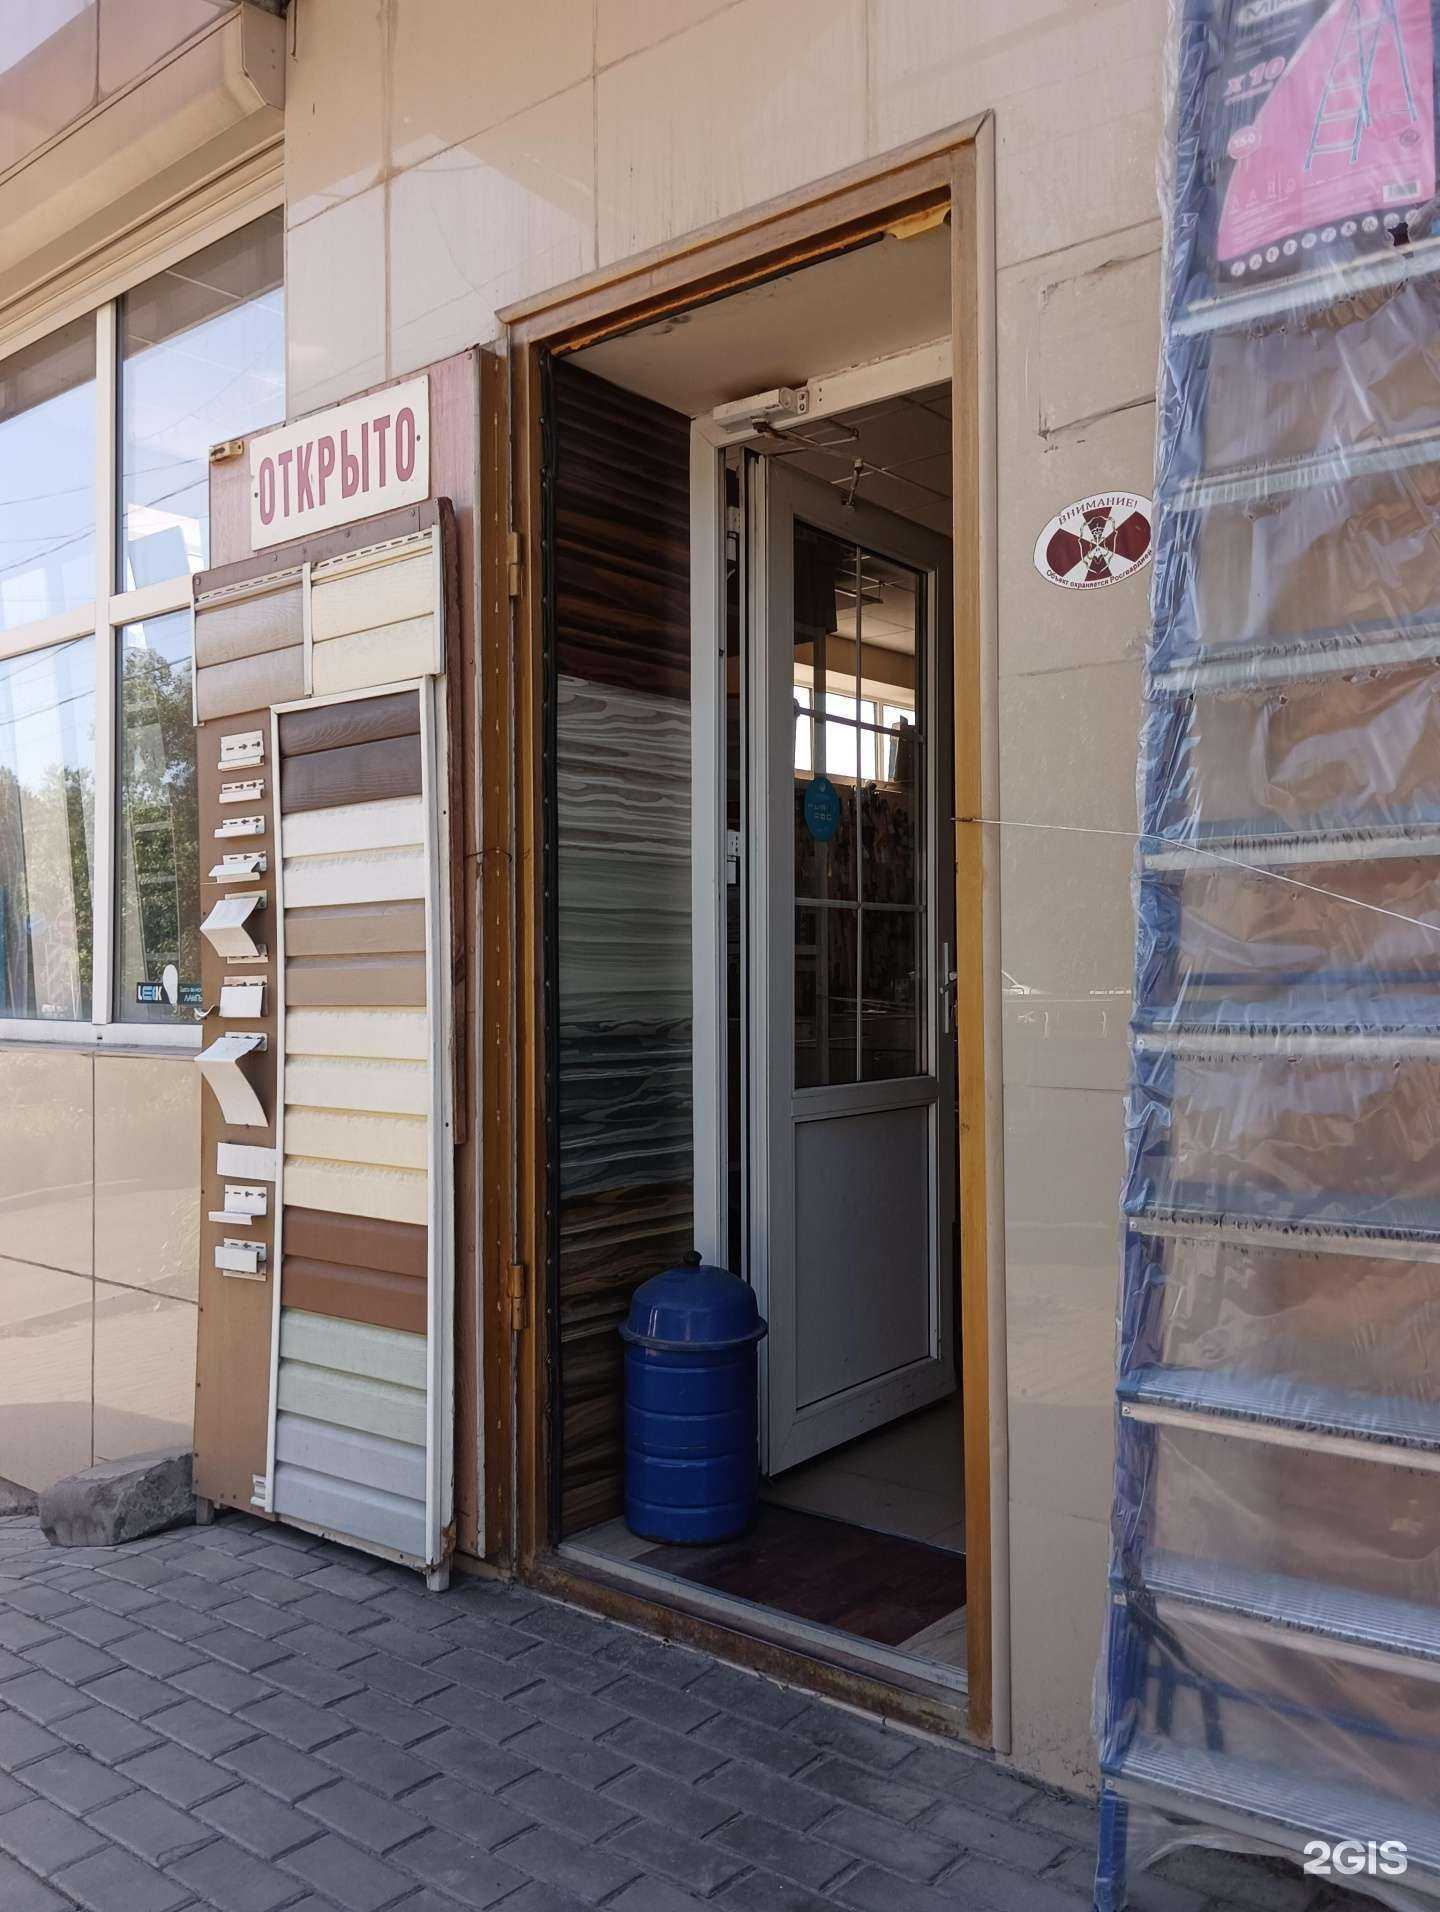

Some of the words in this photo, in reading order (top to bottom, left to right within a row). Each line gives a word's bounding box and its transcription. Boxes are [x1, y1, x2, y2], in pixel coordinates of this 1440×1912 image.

[259, 407, 416, 526] ОТКРЫТО
[1058, 496, 1138, 526] ВНИМАНИЕ!
[1070, 579, 1109, 589] охраняется
